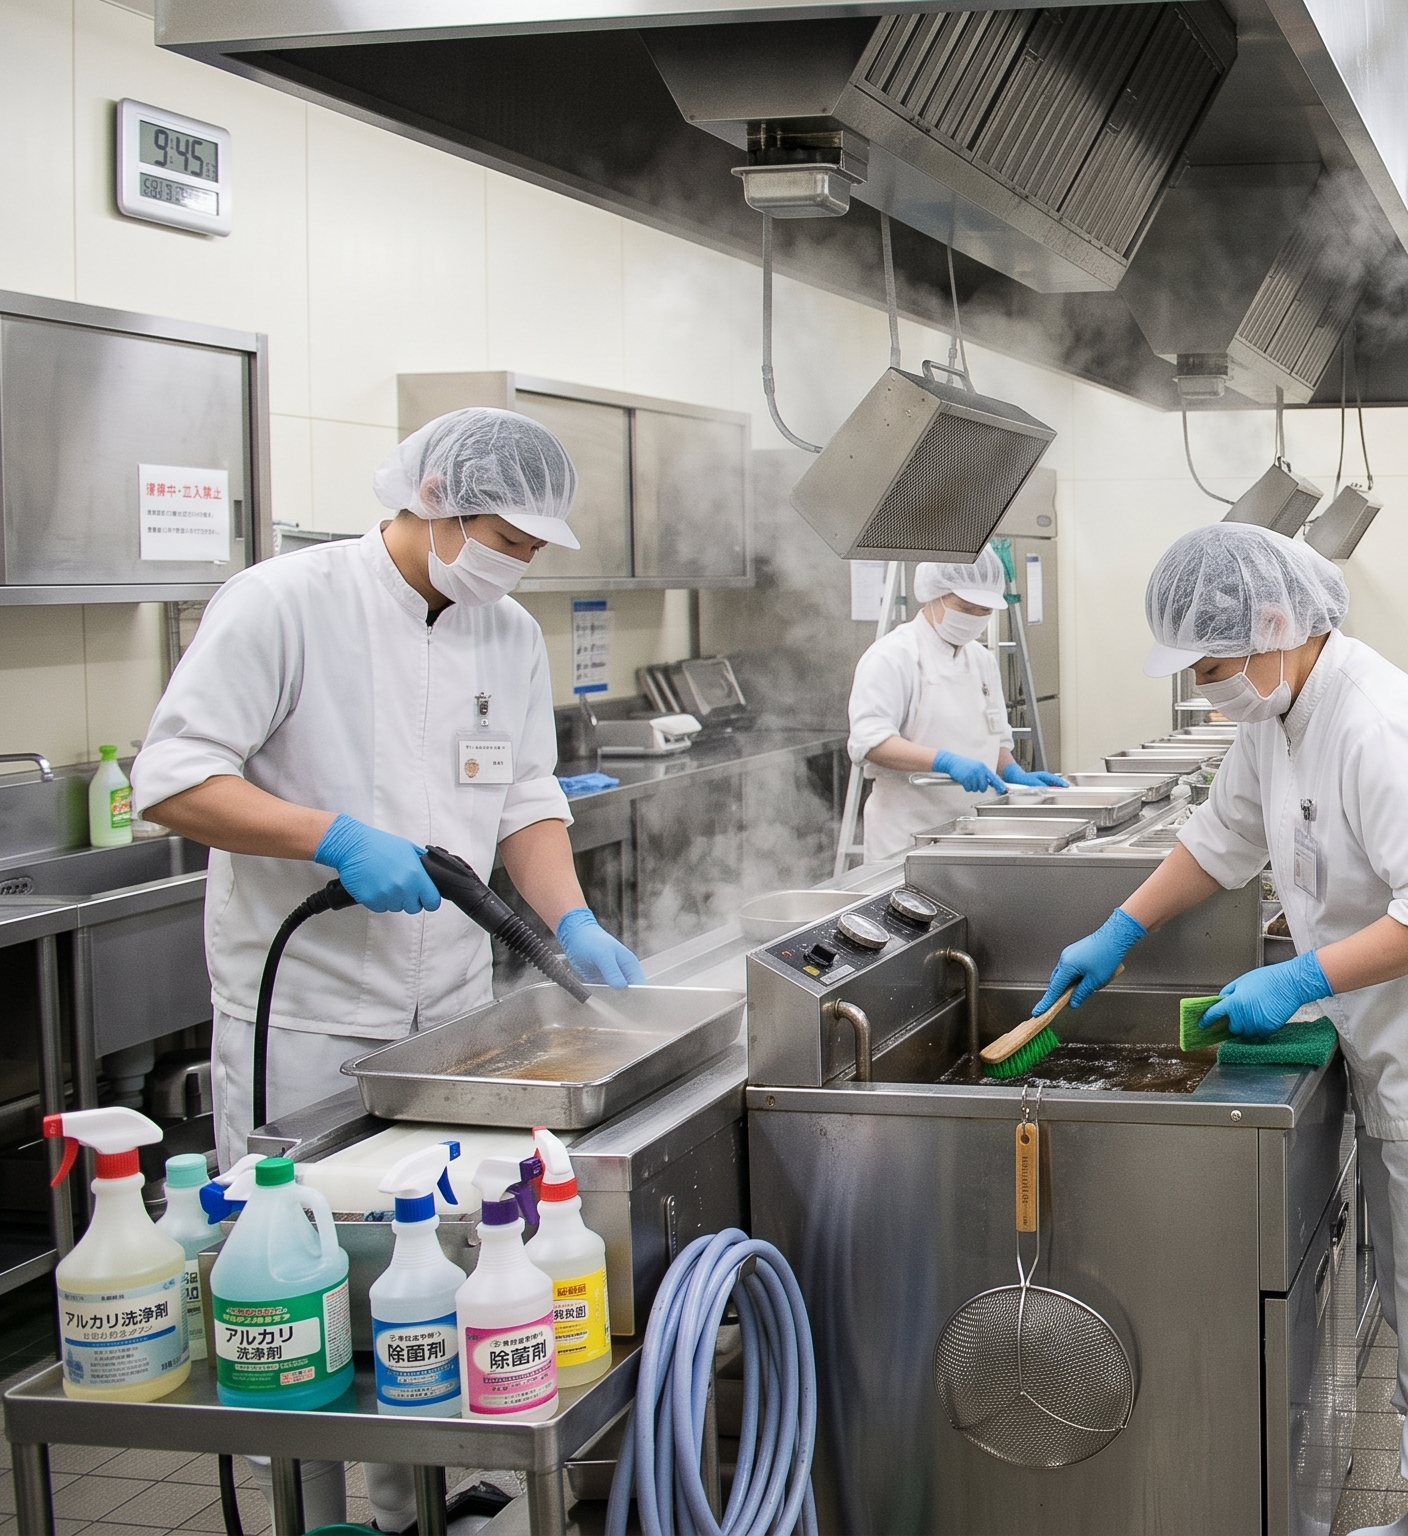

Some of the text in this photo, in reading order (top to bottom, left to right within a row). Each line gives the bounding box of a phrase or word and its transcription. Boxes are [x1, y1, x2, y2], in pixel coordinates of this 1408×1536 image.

[65, 1301, 168, 1330] アルカリ洗浄剤
[225, 1325, 293, 1346] アルカリ
[489, 1338, 547, 1370] 除菌剤
